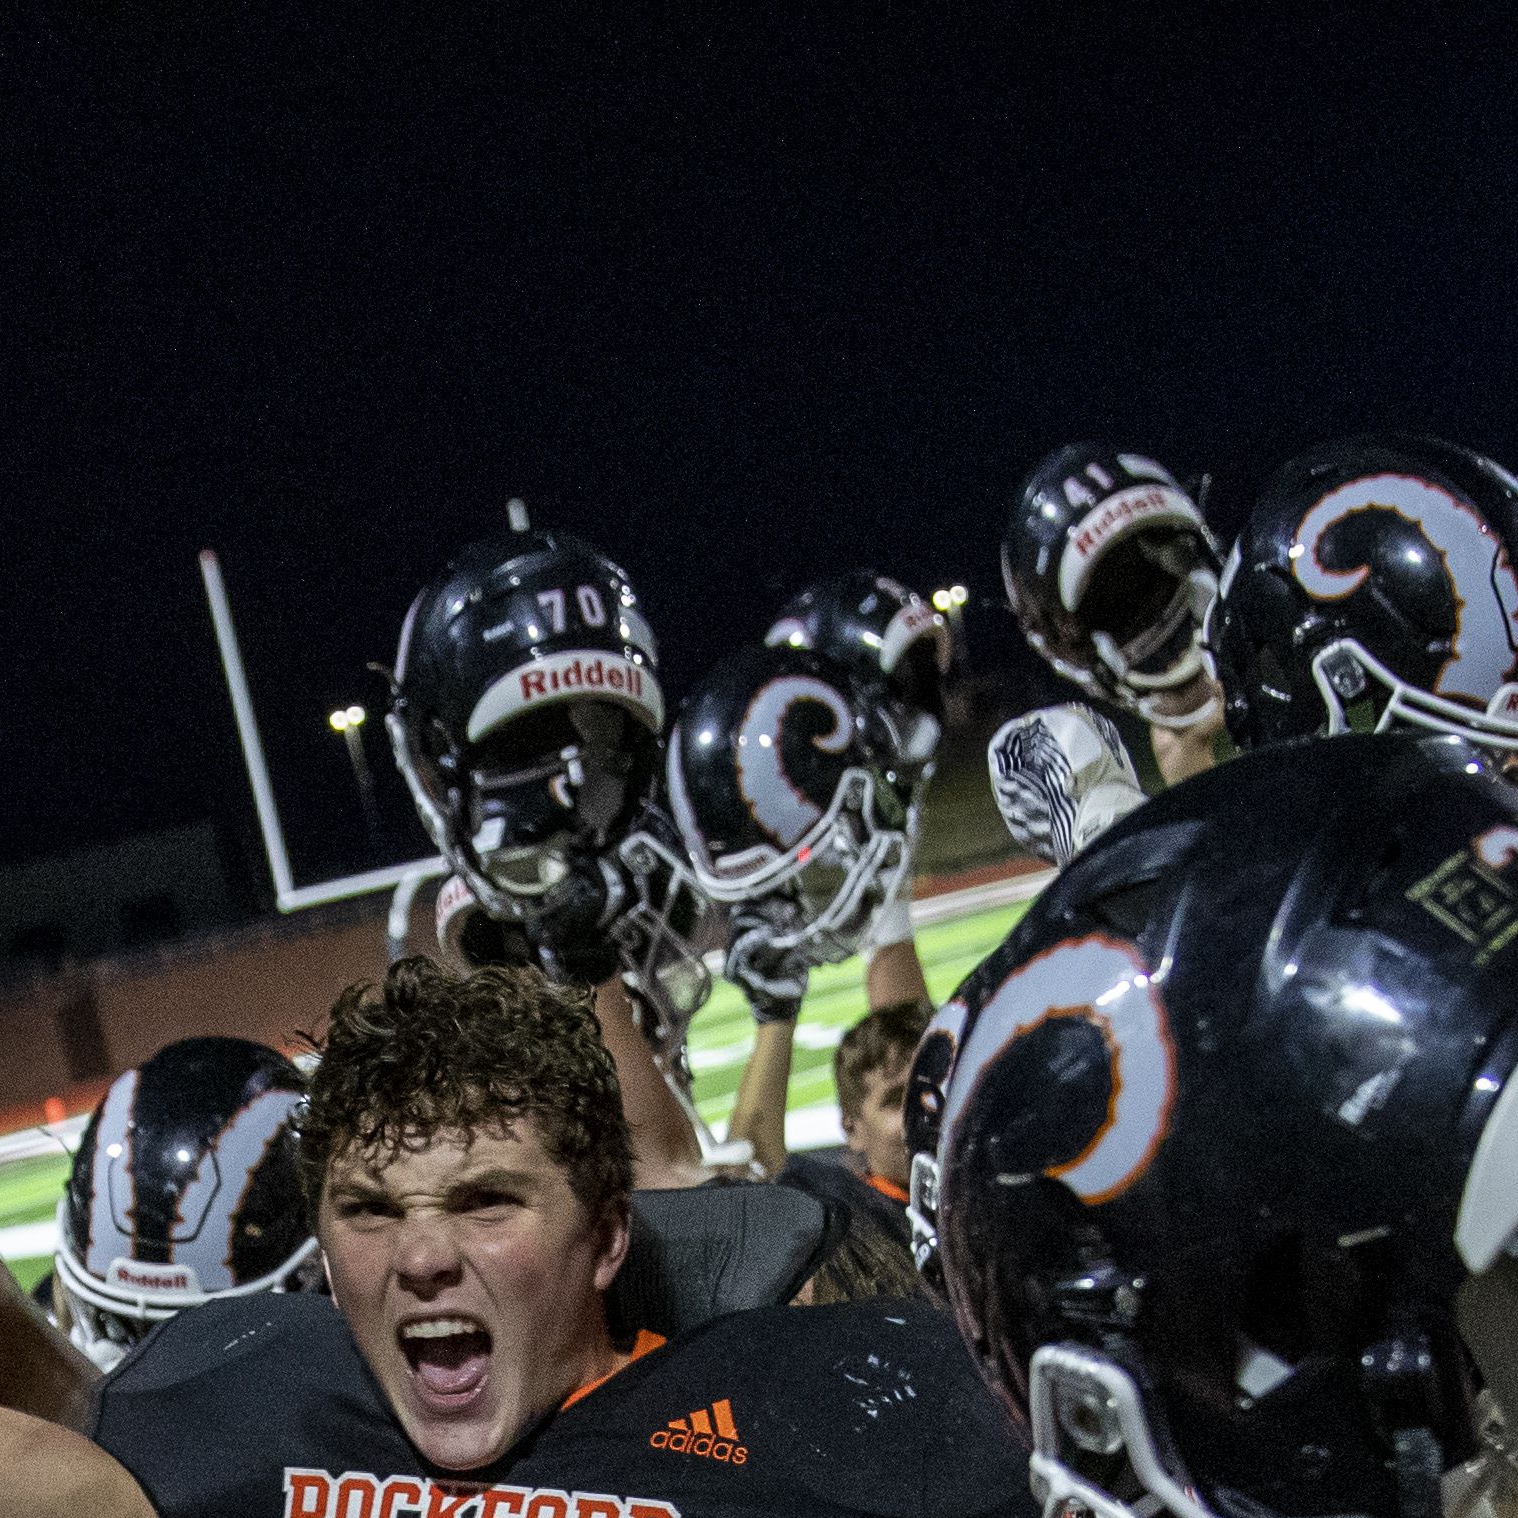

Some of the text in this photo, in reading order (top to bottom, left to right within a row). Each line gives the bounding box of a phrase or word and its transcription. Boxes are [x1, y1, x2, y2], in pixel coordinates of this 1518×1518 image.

[537, 585, 607, 634] 70
[518, 660, 643, 700] Riddell
[650, 1427, 748, 1465] adidas
